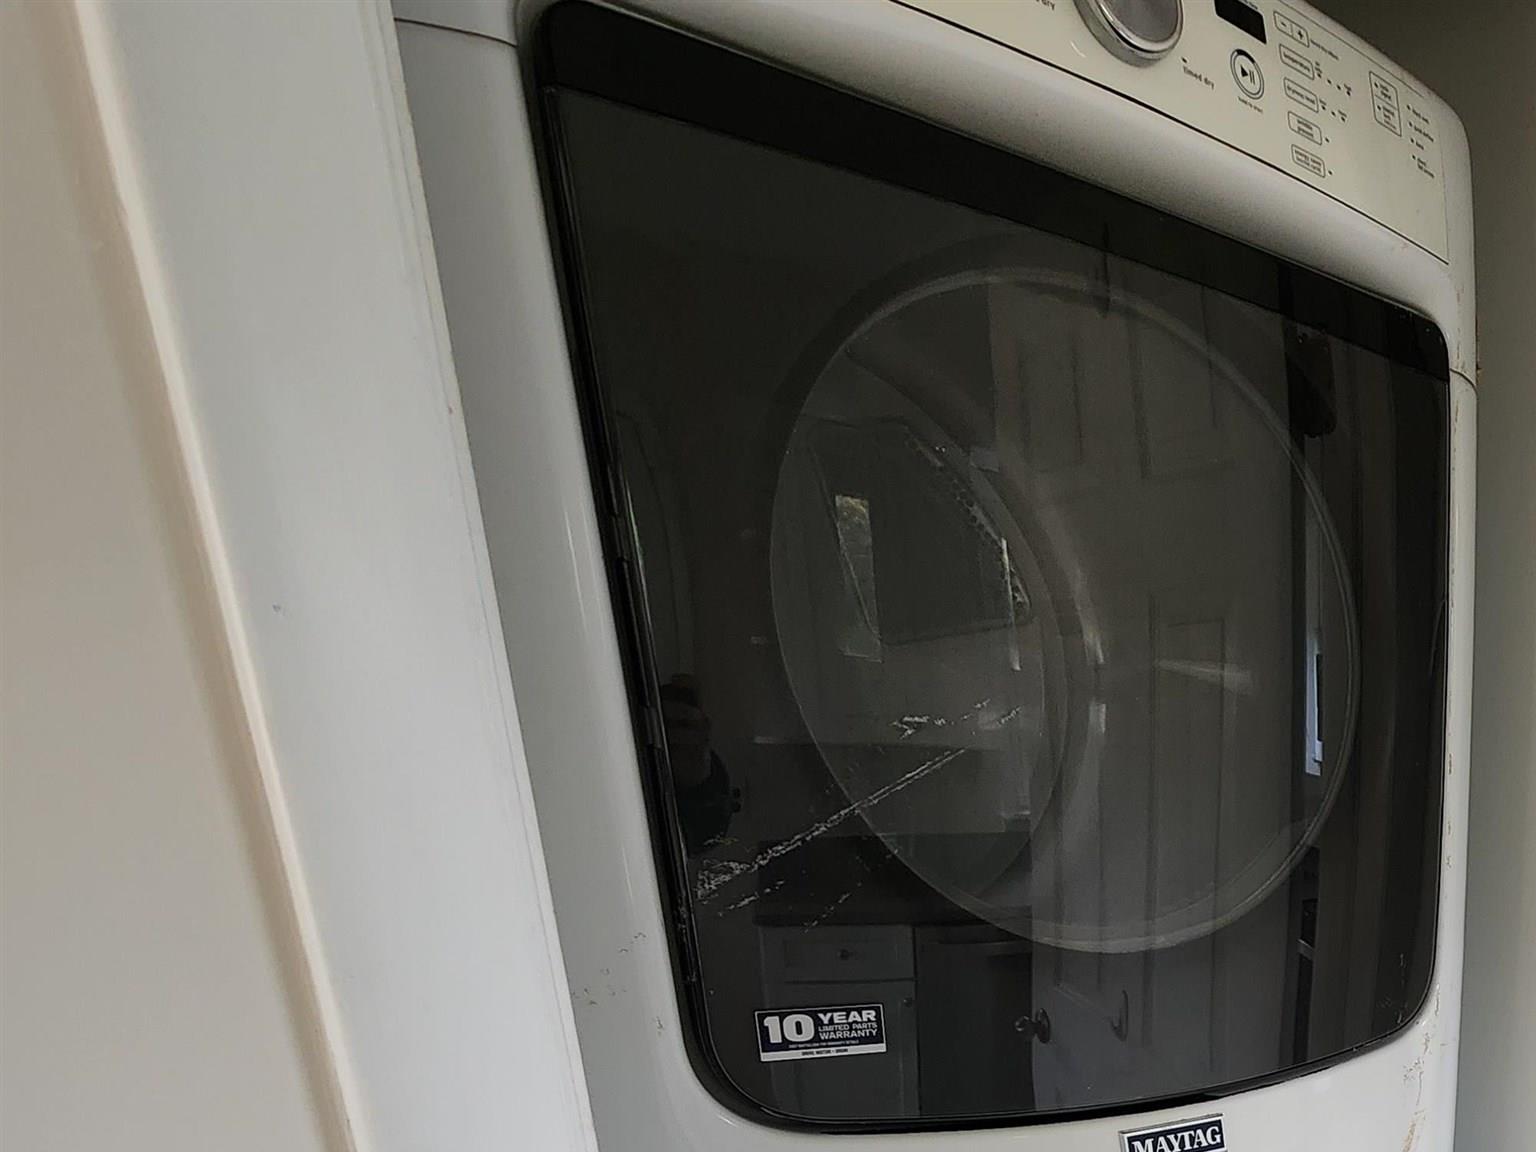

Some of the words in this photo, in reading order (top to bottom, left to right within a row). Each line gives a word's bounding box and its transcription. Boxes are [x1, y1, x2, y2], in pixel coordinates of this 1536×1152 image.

[818, 1010, 877, 1024] YEAR
[763, 1014, 816, 1044] 10
[818, 1023, 850, 1032] LIMITED
[852, 1021, 878, 1030] PARTS
[819, 1028, 878, 1040] WARRANTY
